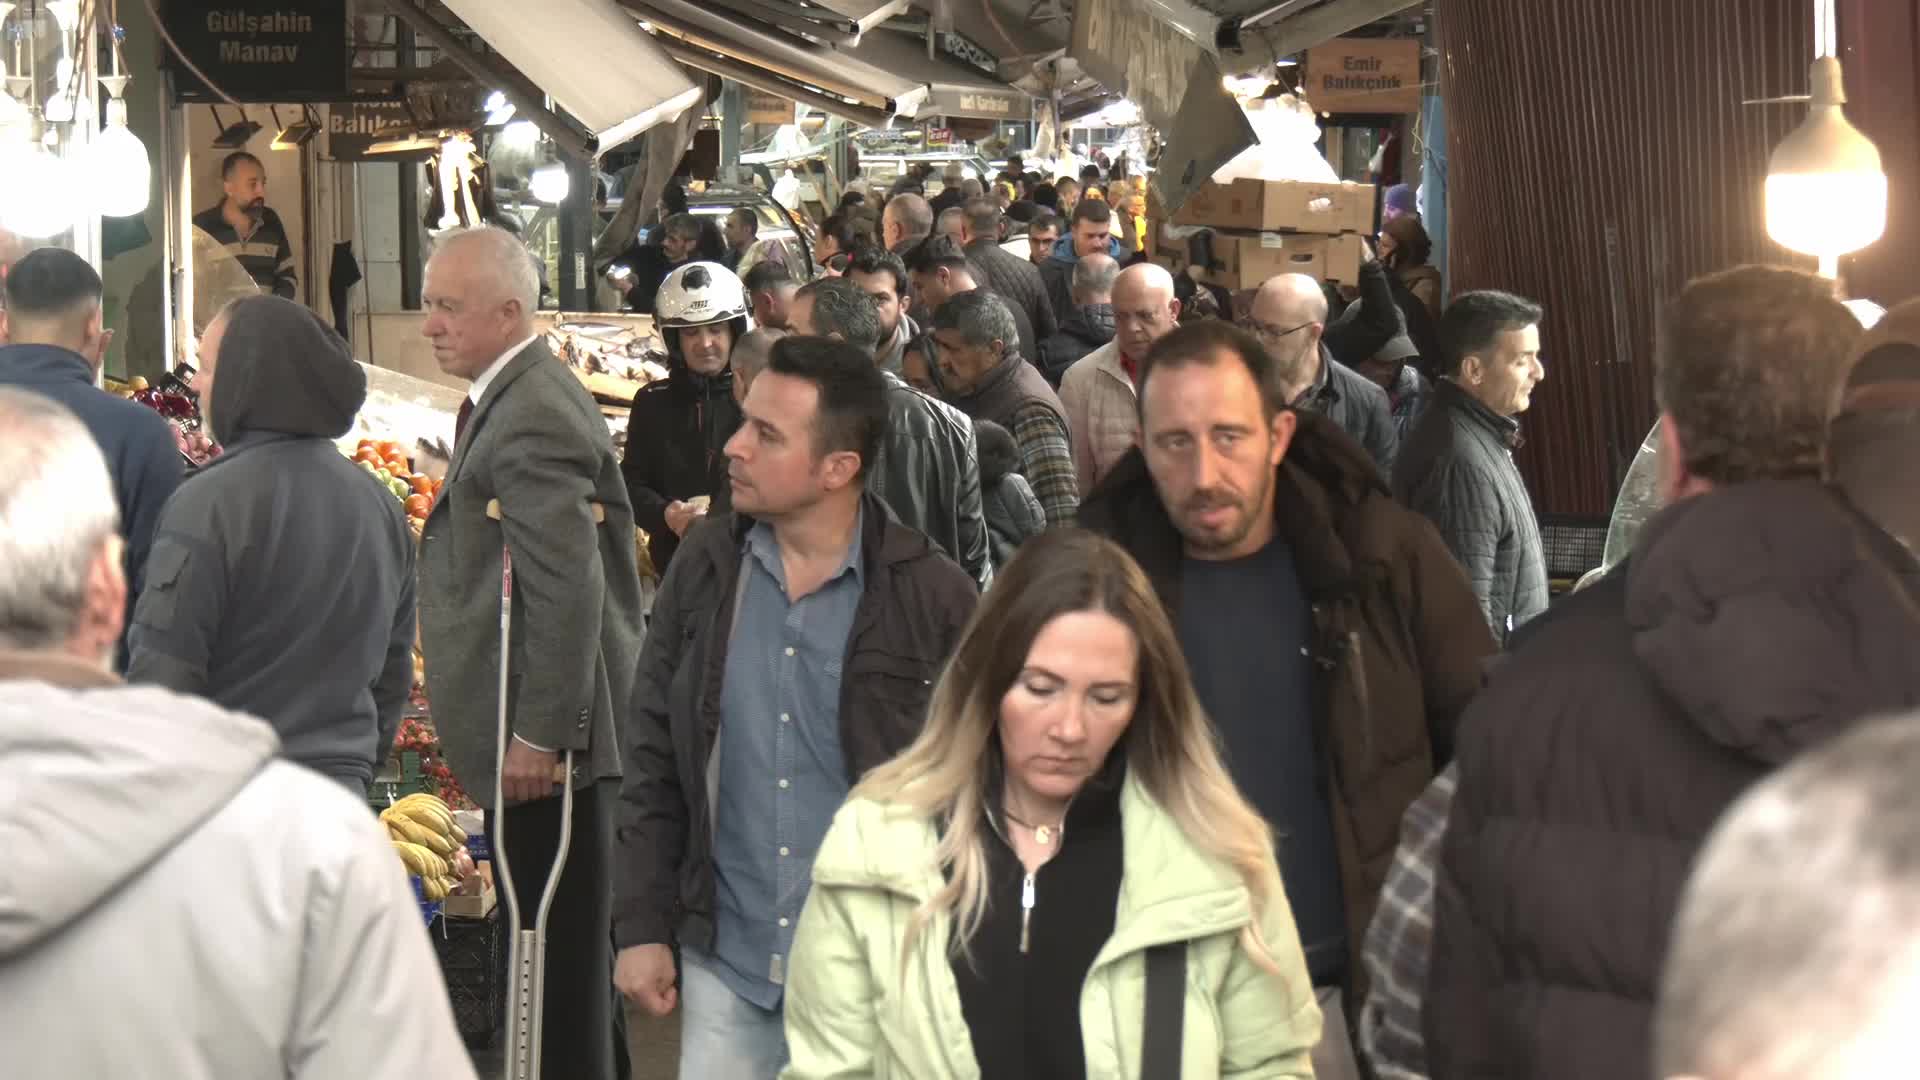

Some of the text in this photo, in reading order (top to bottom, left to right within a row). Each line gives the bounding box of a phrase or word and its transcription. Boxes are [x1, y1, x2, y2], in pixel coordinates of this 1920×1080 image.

[207, 10, 312, 38] Gülşahin
[219, 40, 298, 63] Manav
[1343, 55, 1382, 72] Emir
[1323, 74, 1402, 95] Balıkçılık
